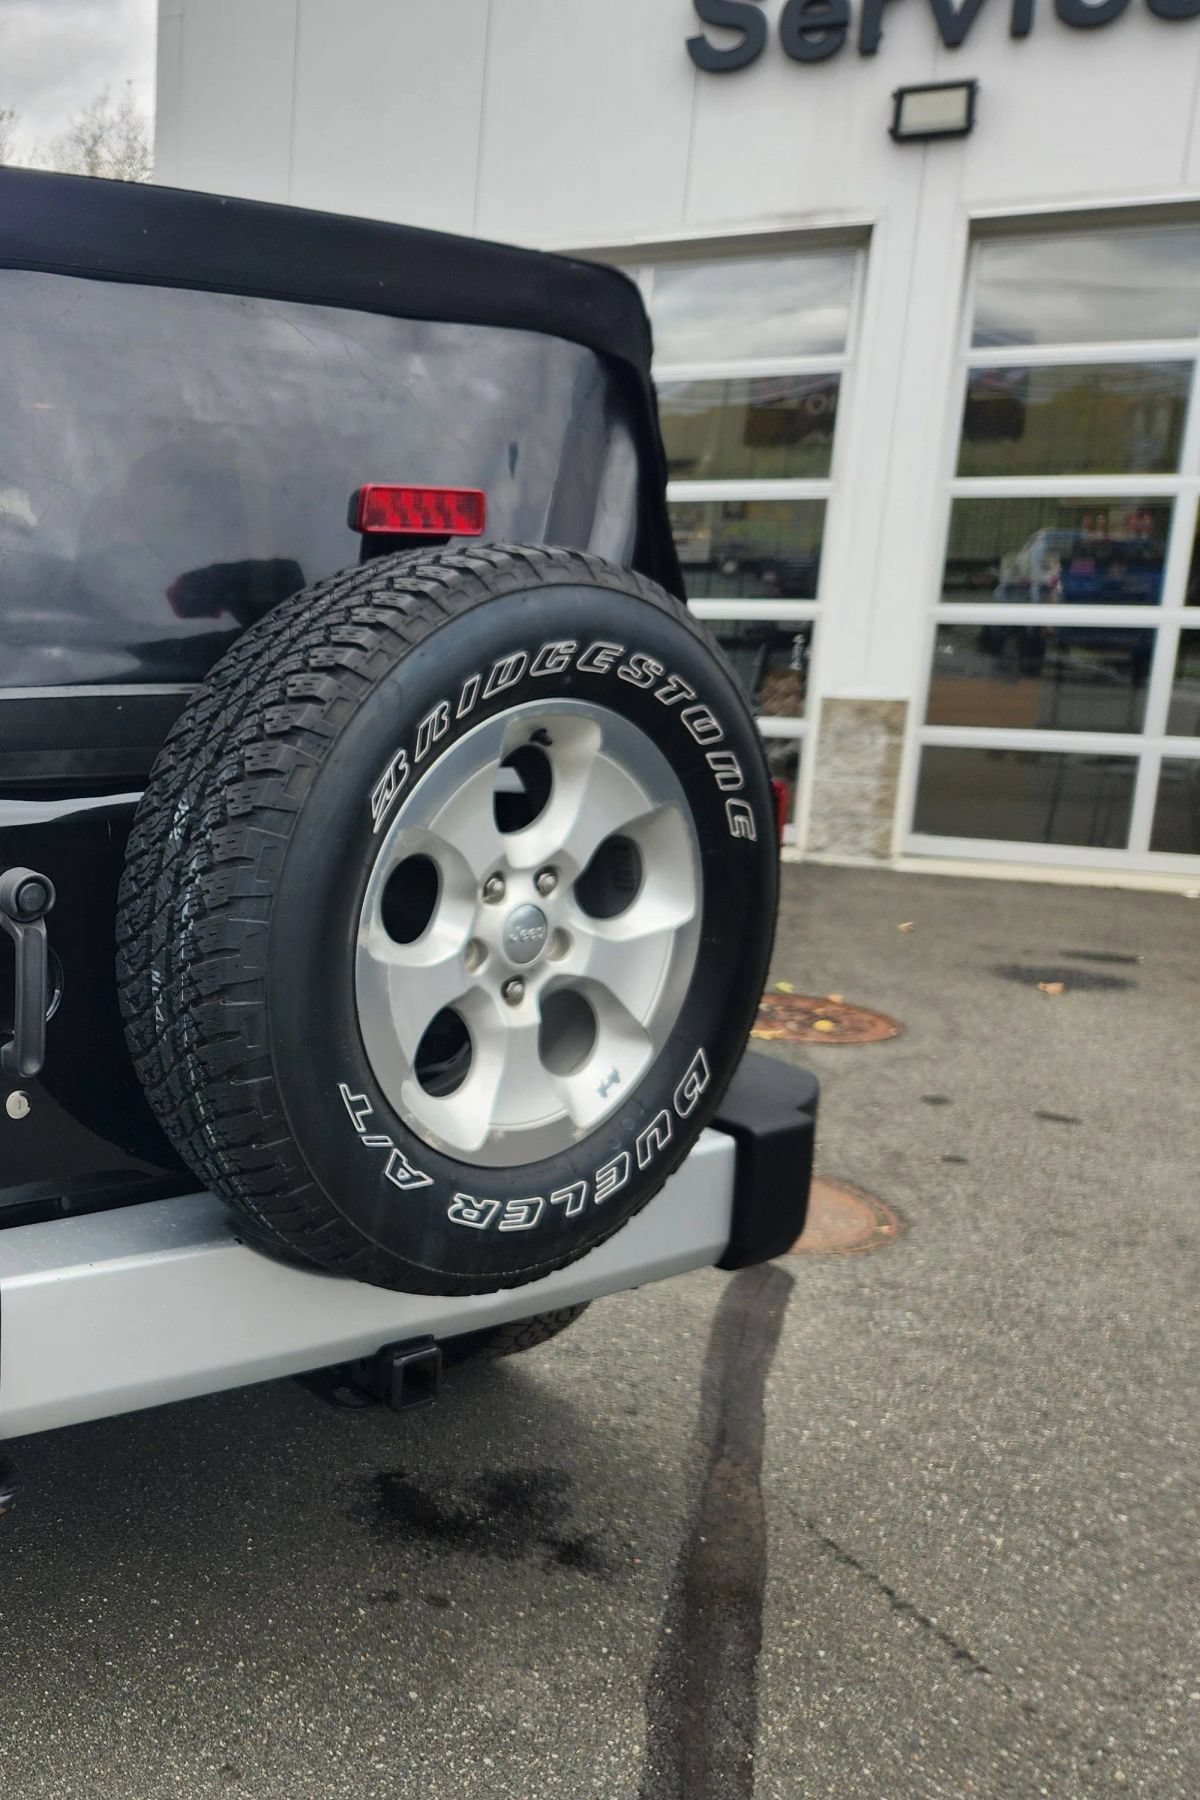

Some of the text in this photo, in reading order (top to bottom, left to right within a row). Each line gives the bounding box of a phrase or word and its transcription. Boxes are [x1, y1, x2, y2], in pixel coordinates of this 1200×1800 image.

[686, 0, 1200, 74] Serv
[371, 640, 757, 842] BRIDGESTONE
[509, 925, 545, 943] Jeep
[337, 1047, 711, 1232] DUELER A/T
